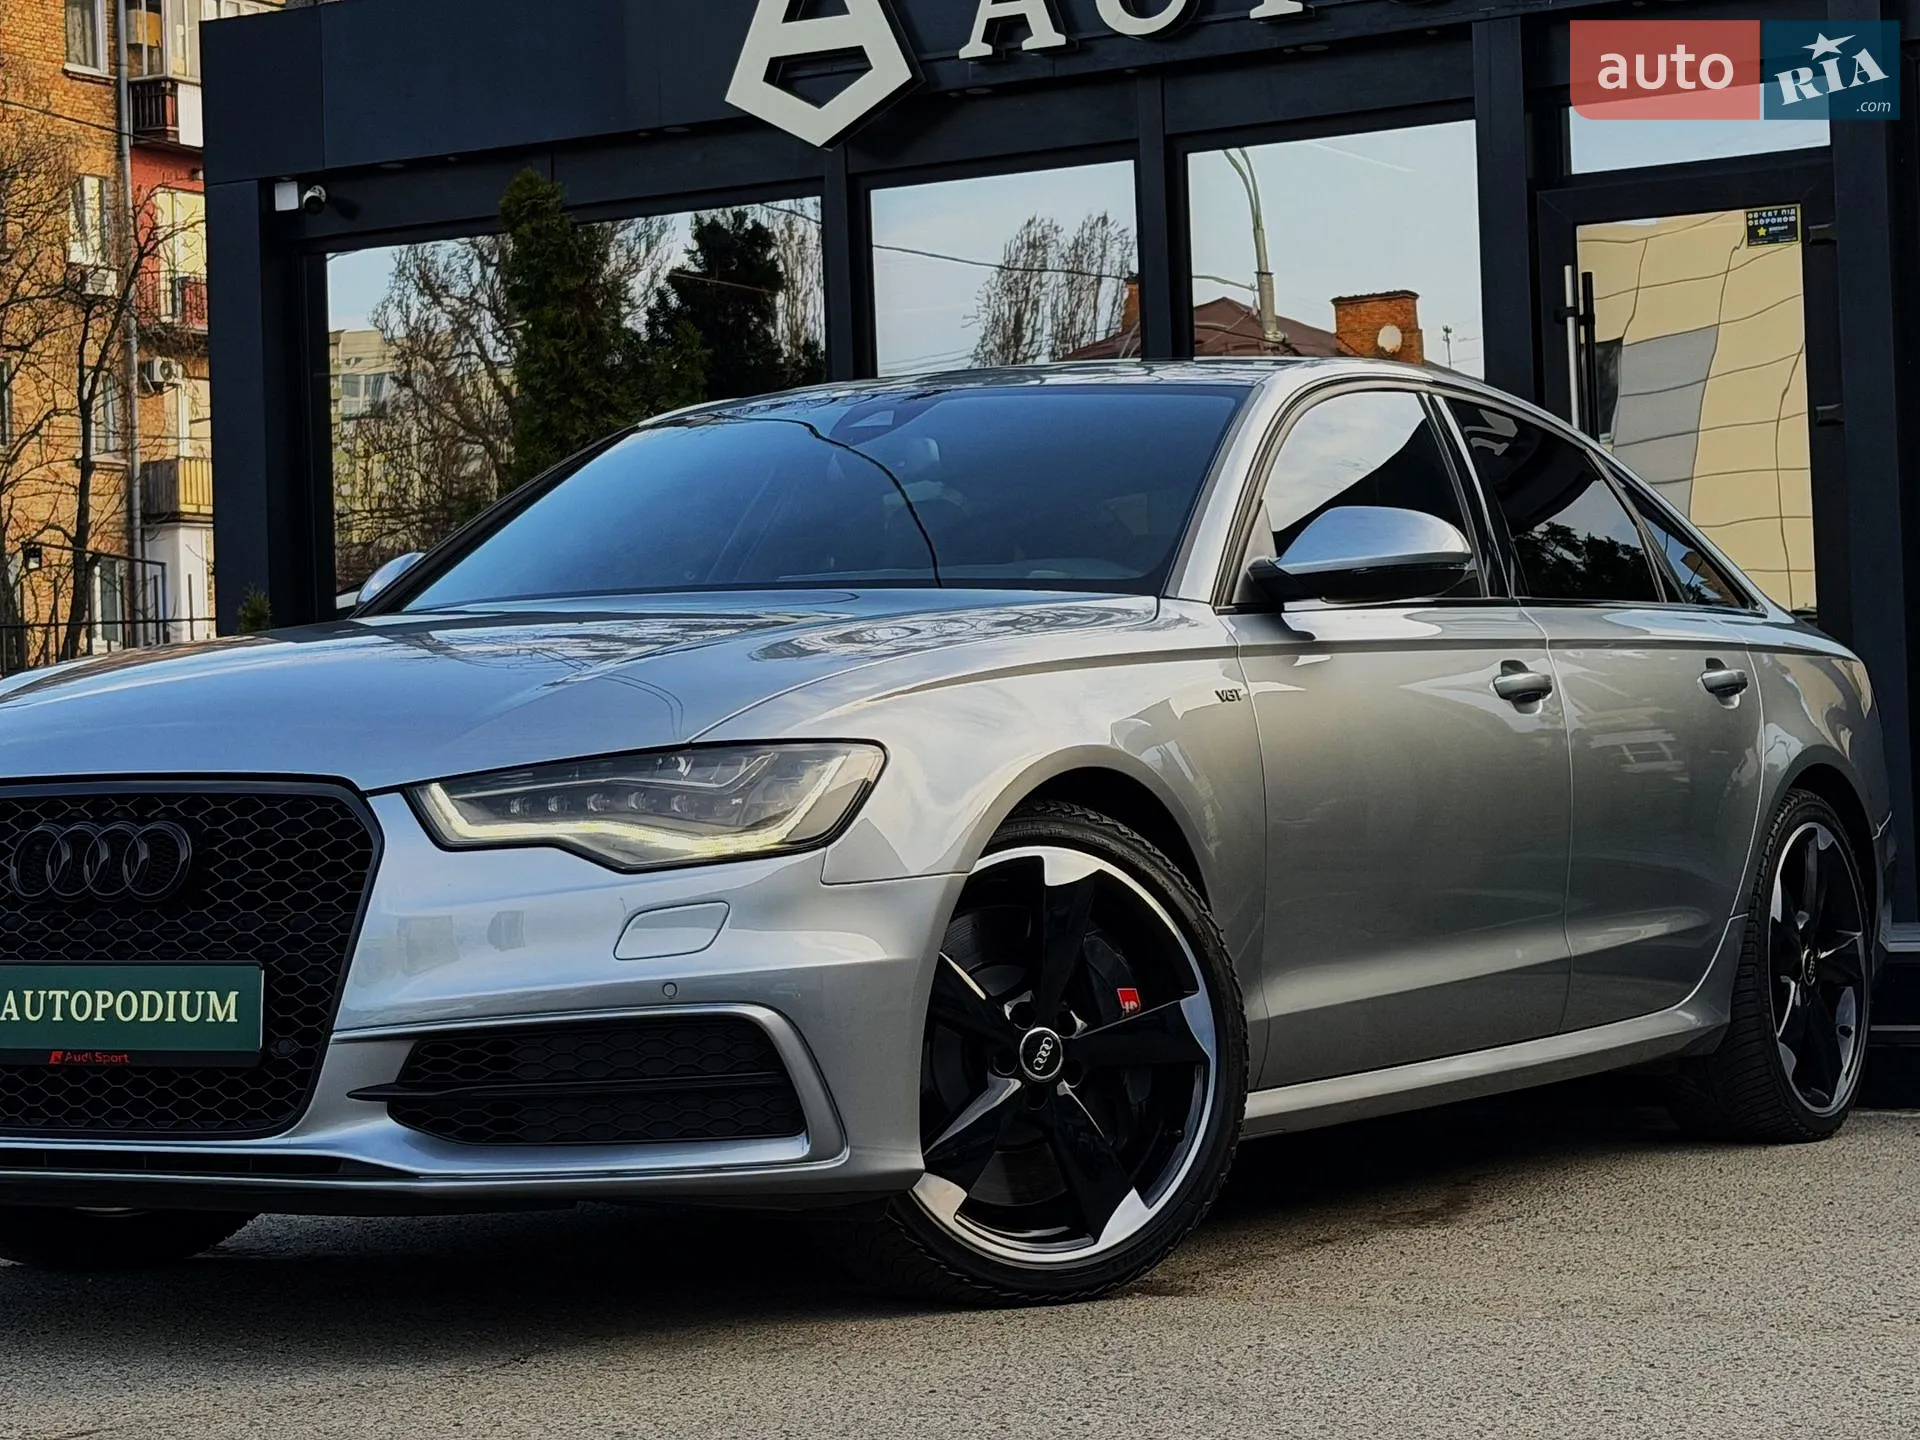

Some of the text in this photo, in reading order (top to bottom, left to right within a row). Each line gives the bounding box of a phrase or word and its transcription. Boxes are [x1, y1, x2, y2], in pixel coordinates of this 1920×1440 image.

[1747, 216, 1797, 226] ОХОРОНОЮ
[0, 990, 240, 1022] AUTOPODIUM
[65, 1051, 130, 1065] Audi Sport
